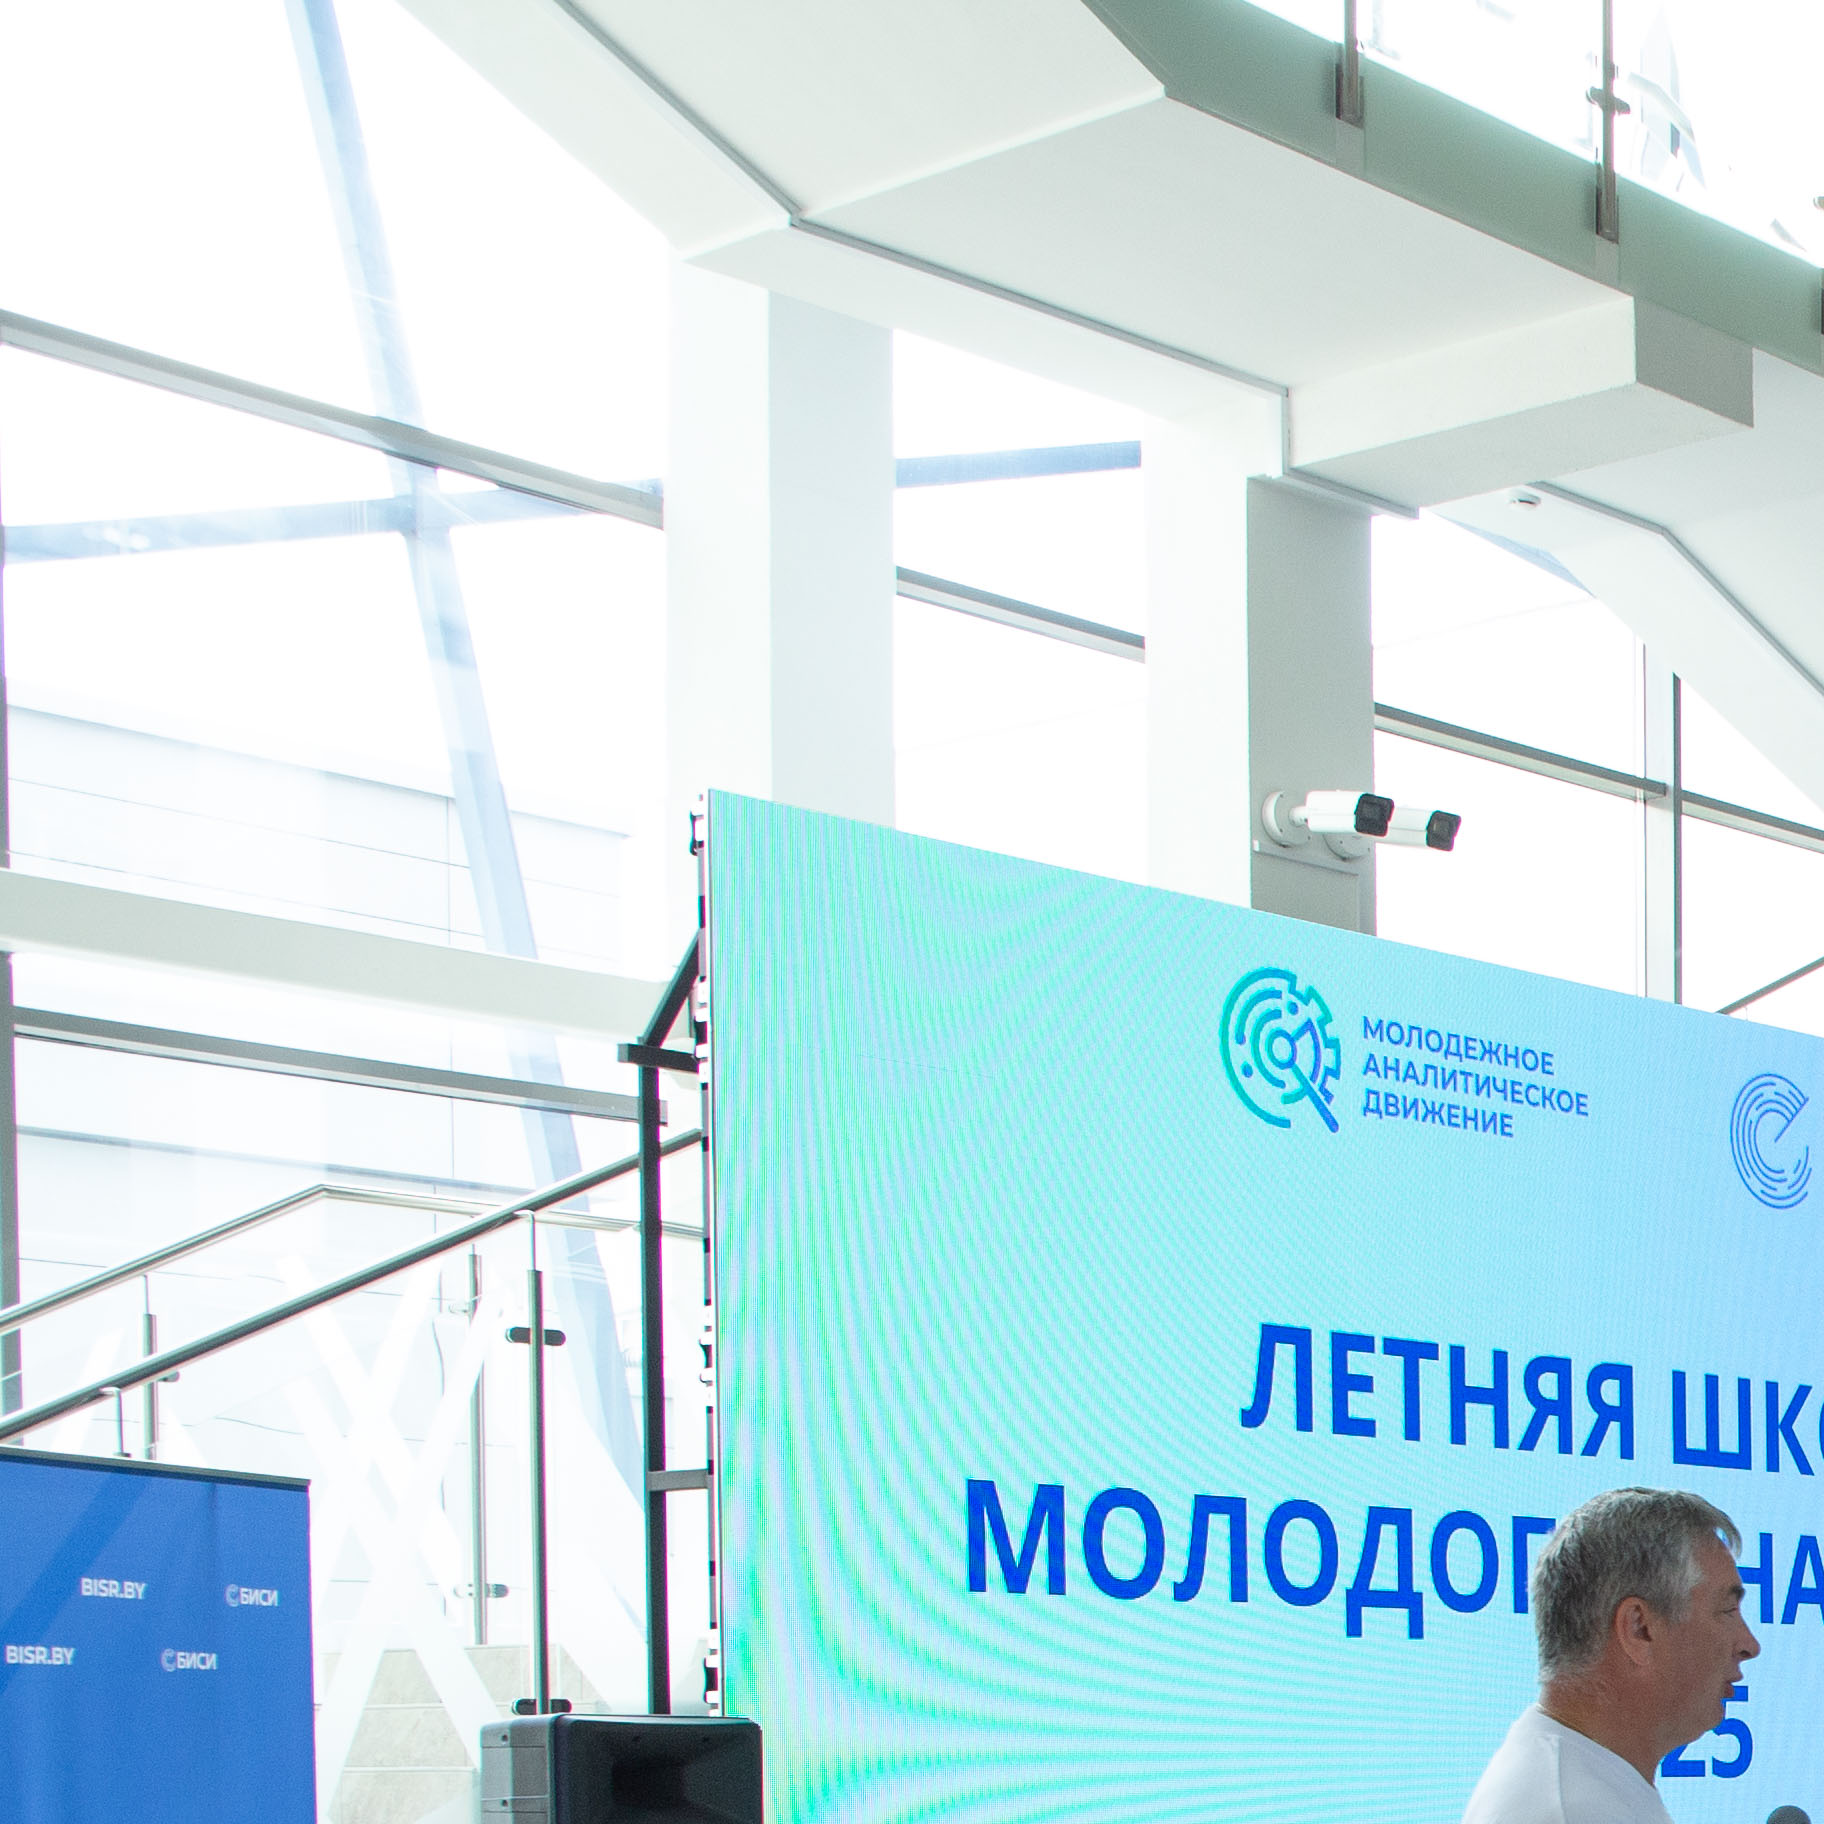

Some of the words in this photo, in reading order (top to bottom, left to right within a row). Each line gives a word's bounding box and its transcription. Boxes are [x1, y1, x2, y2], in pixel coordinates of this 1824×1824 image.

[1362, 1015, 1555, 1077] МОЛОДЕЖНОЕ
[1362, 1052, 1589, 1118] АНАЛИТИЧЕСКОЕ
[1362, 1091, 1514, 1138] ДВИЖЕНИЕ
[1241, 1322, 1636, 1460] ЛЕТНЯЯ
[965, 1478, 1557, 1640] МОЛОДОГ
[81, 1577, 146, 1601] BISR.BY
[239, 1586, 278, 1607] БИСИ
[5, 1645, 75, 1667] BISR.BY
[176, 1650, 217, 1671] БИСИ
[1661, 1685, 1754, 1779] 25
